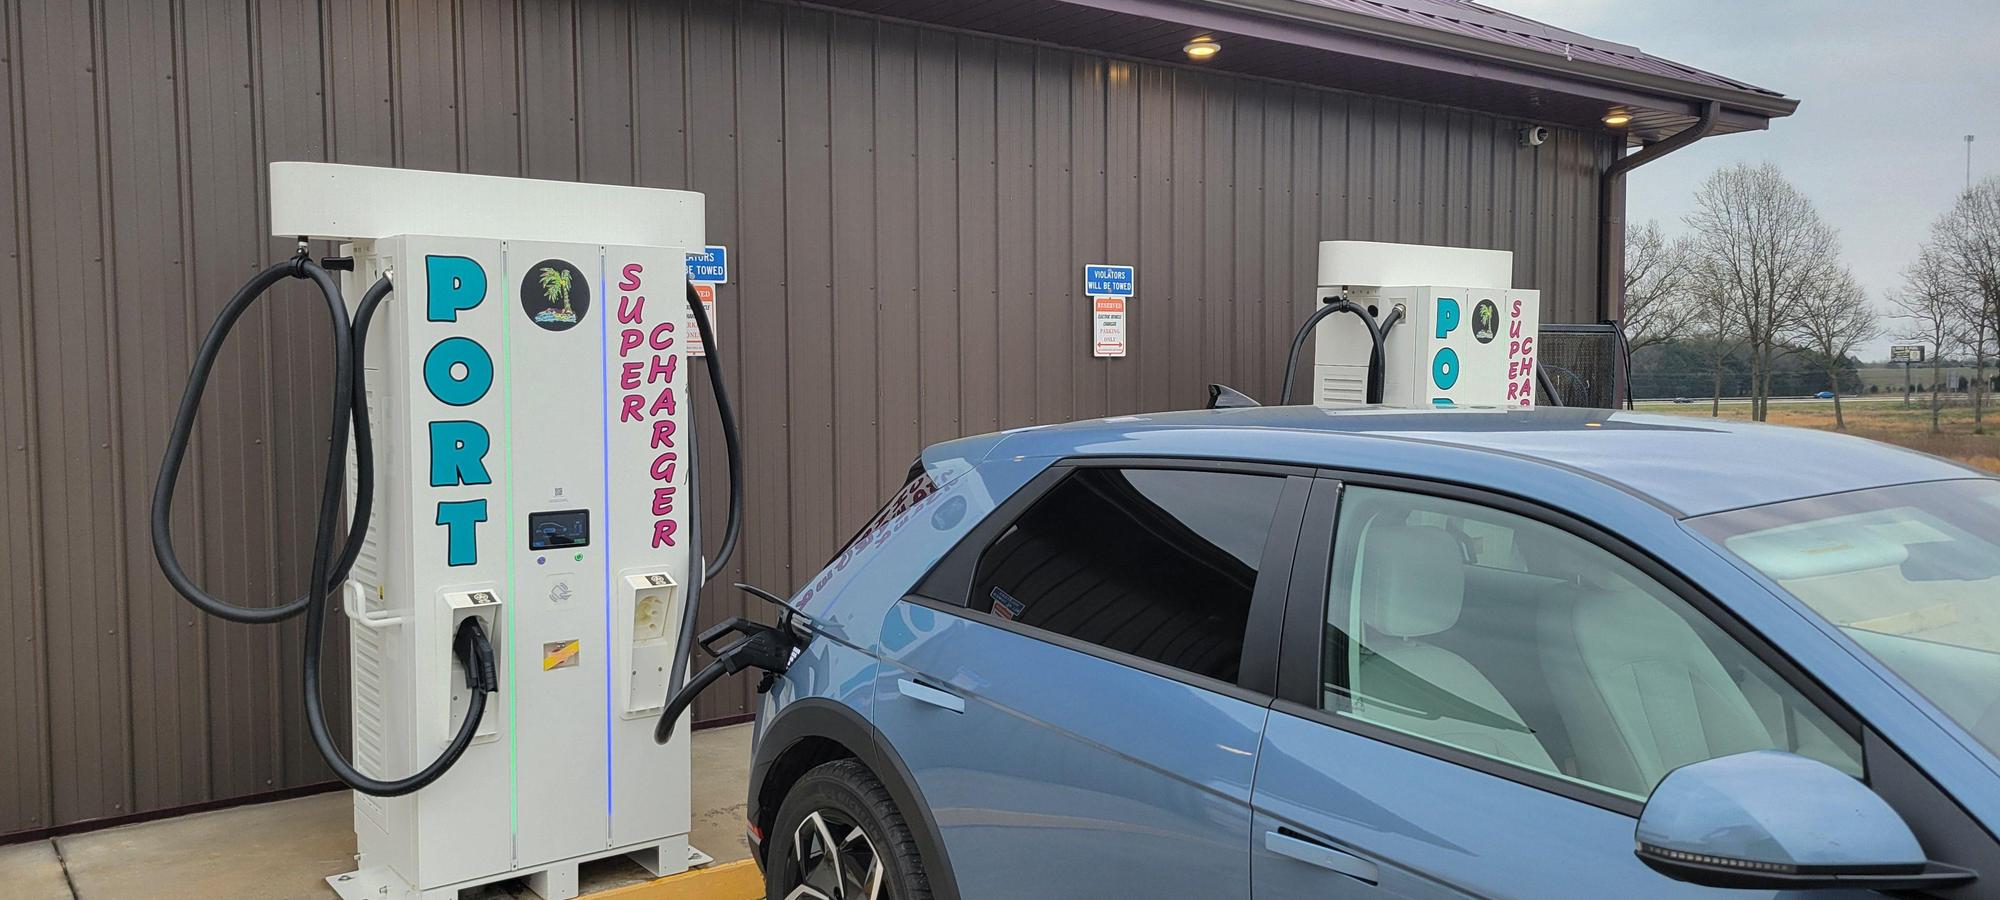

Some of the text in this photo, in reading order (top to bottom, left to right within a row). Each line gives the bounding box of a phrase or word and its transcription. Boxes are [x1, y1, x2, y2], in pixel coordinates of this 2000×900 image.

[697, 265, 724, 275] TOWED
[1088, 281, 1131, 291] WILL BE TOWED
[1095, 271, 1125, 279] VIOLATORS
[617, 263, 646, 423] SUPER
[1432, 297, 1460, 404] PO
[1507, 299, 1522, 400] SUPER
[423, 254, 494, 567] PORT
[647, 322, 678, 548] CHARGER
